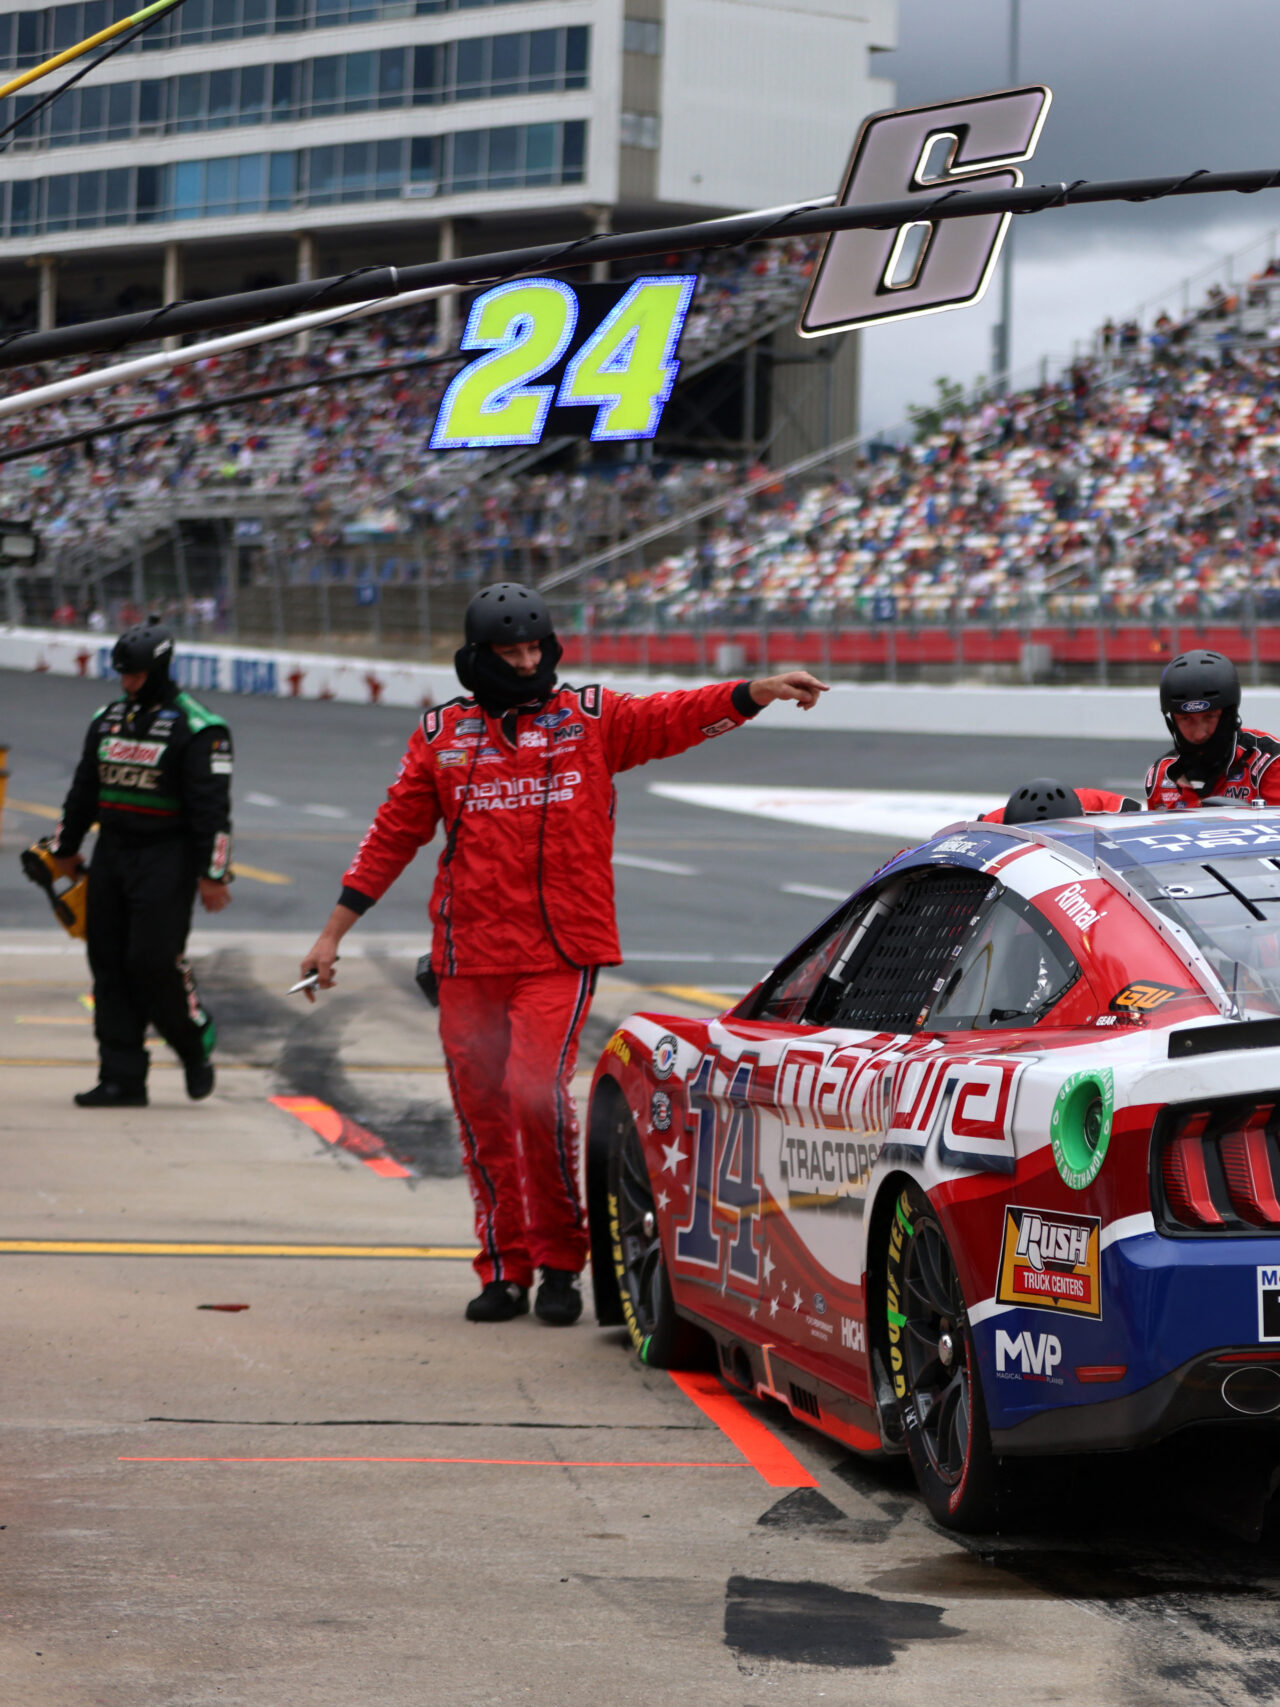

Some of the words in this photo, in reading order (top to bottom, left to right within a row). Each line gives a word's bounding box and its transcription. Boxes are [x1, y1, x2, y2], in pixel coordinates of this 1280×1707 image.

[798, 84, 1053, 338] 6
[428, 274, 698, 450] 24
[1184, 702, 1208, 712] Ford
[455, 771, 581, 801] mahindra
[465, 788, 574, 813] TRACTORS
[1224, 786, 1250, 800] MVP
[1053, 882, 1108, 933] Rinnai
[674, 1050, 766, 1288] 14
[1015, 1213, 1090, 1272] RUSH
[1023, 1271, 1051, 1292] TRUCK
[1051, 1274, 1085, 1297] CENTERS
[995, 1328, 1062, 1376] MVP
